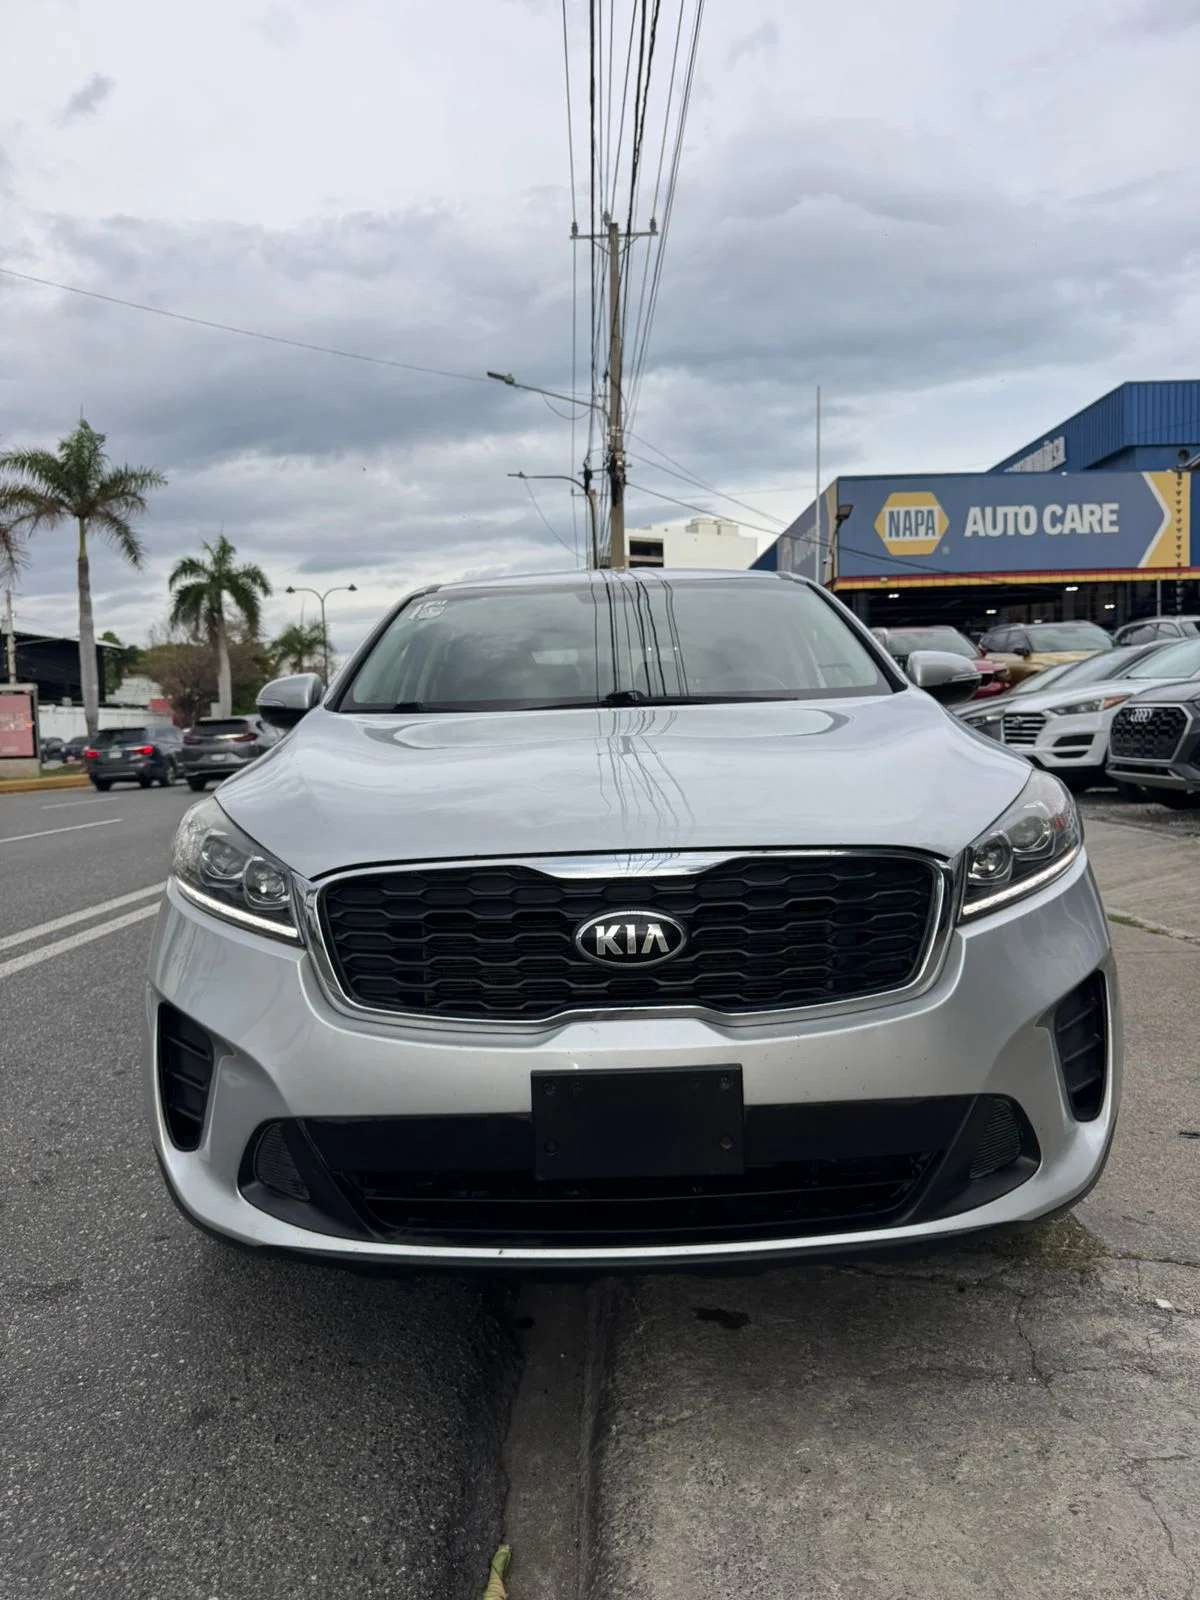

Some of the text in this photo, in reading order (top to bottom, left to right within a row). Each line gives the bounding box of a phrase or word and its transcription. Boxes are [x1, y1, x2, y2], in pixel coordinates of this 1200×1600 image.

[888, 509, 936, 538] NAPA
[964, 503, 1119, 537] AUTO CARE
[595, 923, 670, 955] KIA
